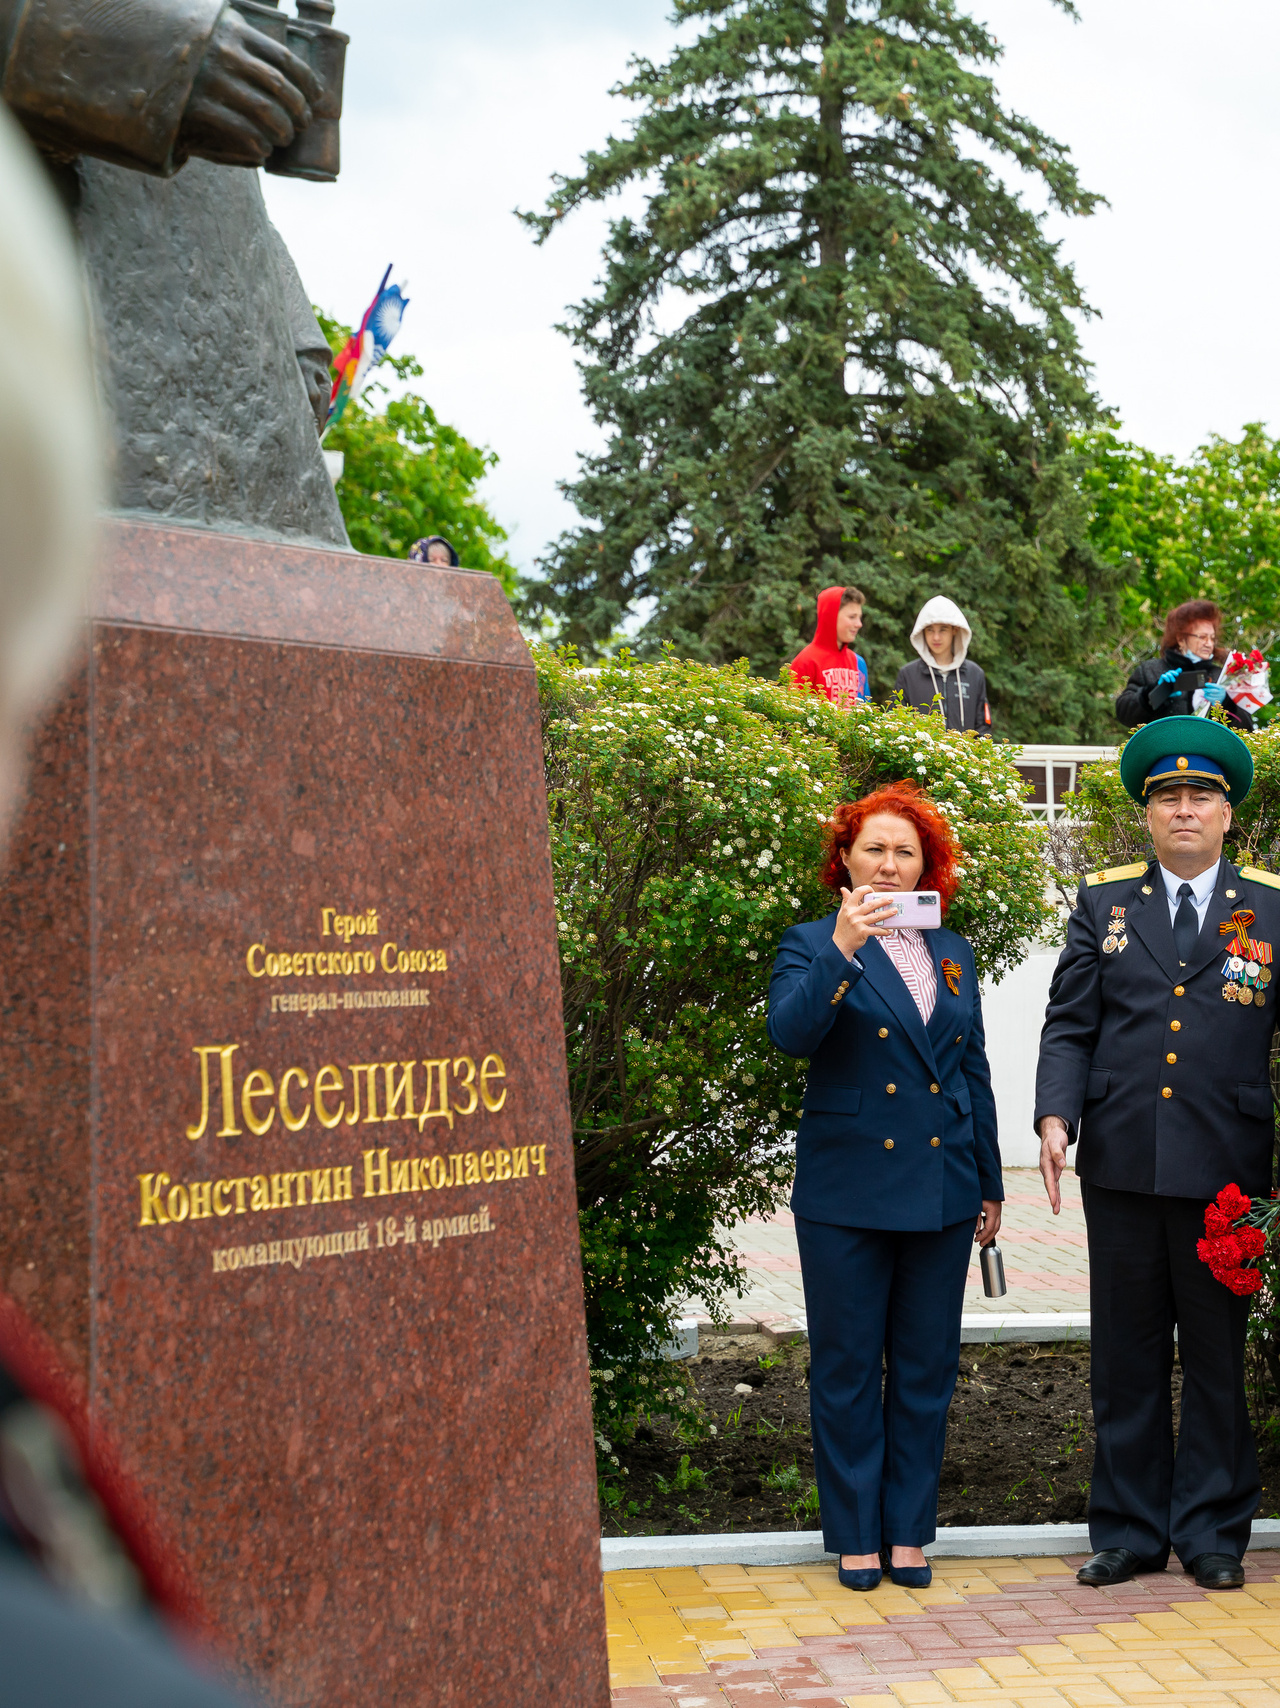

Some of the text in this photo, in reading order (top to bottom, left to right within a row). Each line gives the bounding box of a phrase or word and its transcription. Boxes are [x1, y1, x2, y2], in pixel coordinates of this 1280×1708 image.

[320, 907, 379, 942] Герой
[246, 942, 448, 978] Советского Союза
[270, 986, 431, 1017] генерал-полковник
[185, 1043, 508, 1141] Леселидзе
[137, 1143, 547, 1227] Константин Николаевич
[212, 1205, 496, 1273] командующий 18-й армией.
